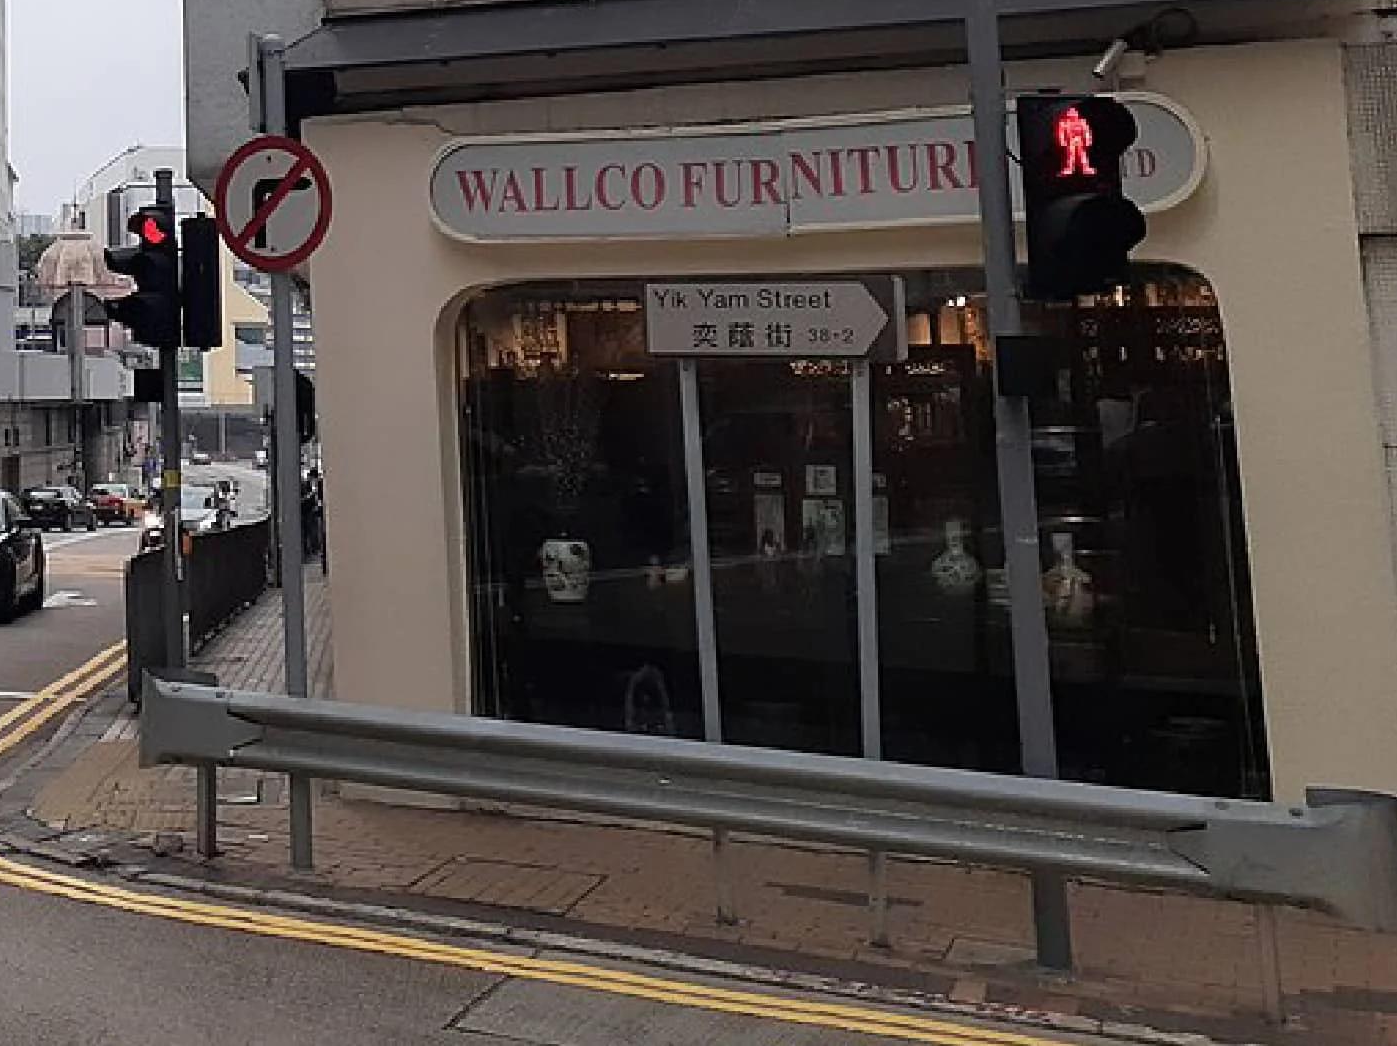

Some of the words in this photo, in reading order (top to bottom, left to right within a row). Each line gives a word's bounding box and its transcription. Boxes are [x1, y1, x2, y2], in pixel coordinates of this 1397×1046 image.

[454, 162, 666, 214] WALLCO
[652, 288, 687, 309] Yik
[696, 288, 750, 309] Yam
[756, 288, 831, 309] Street
